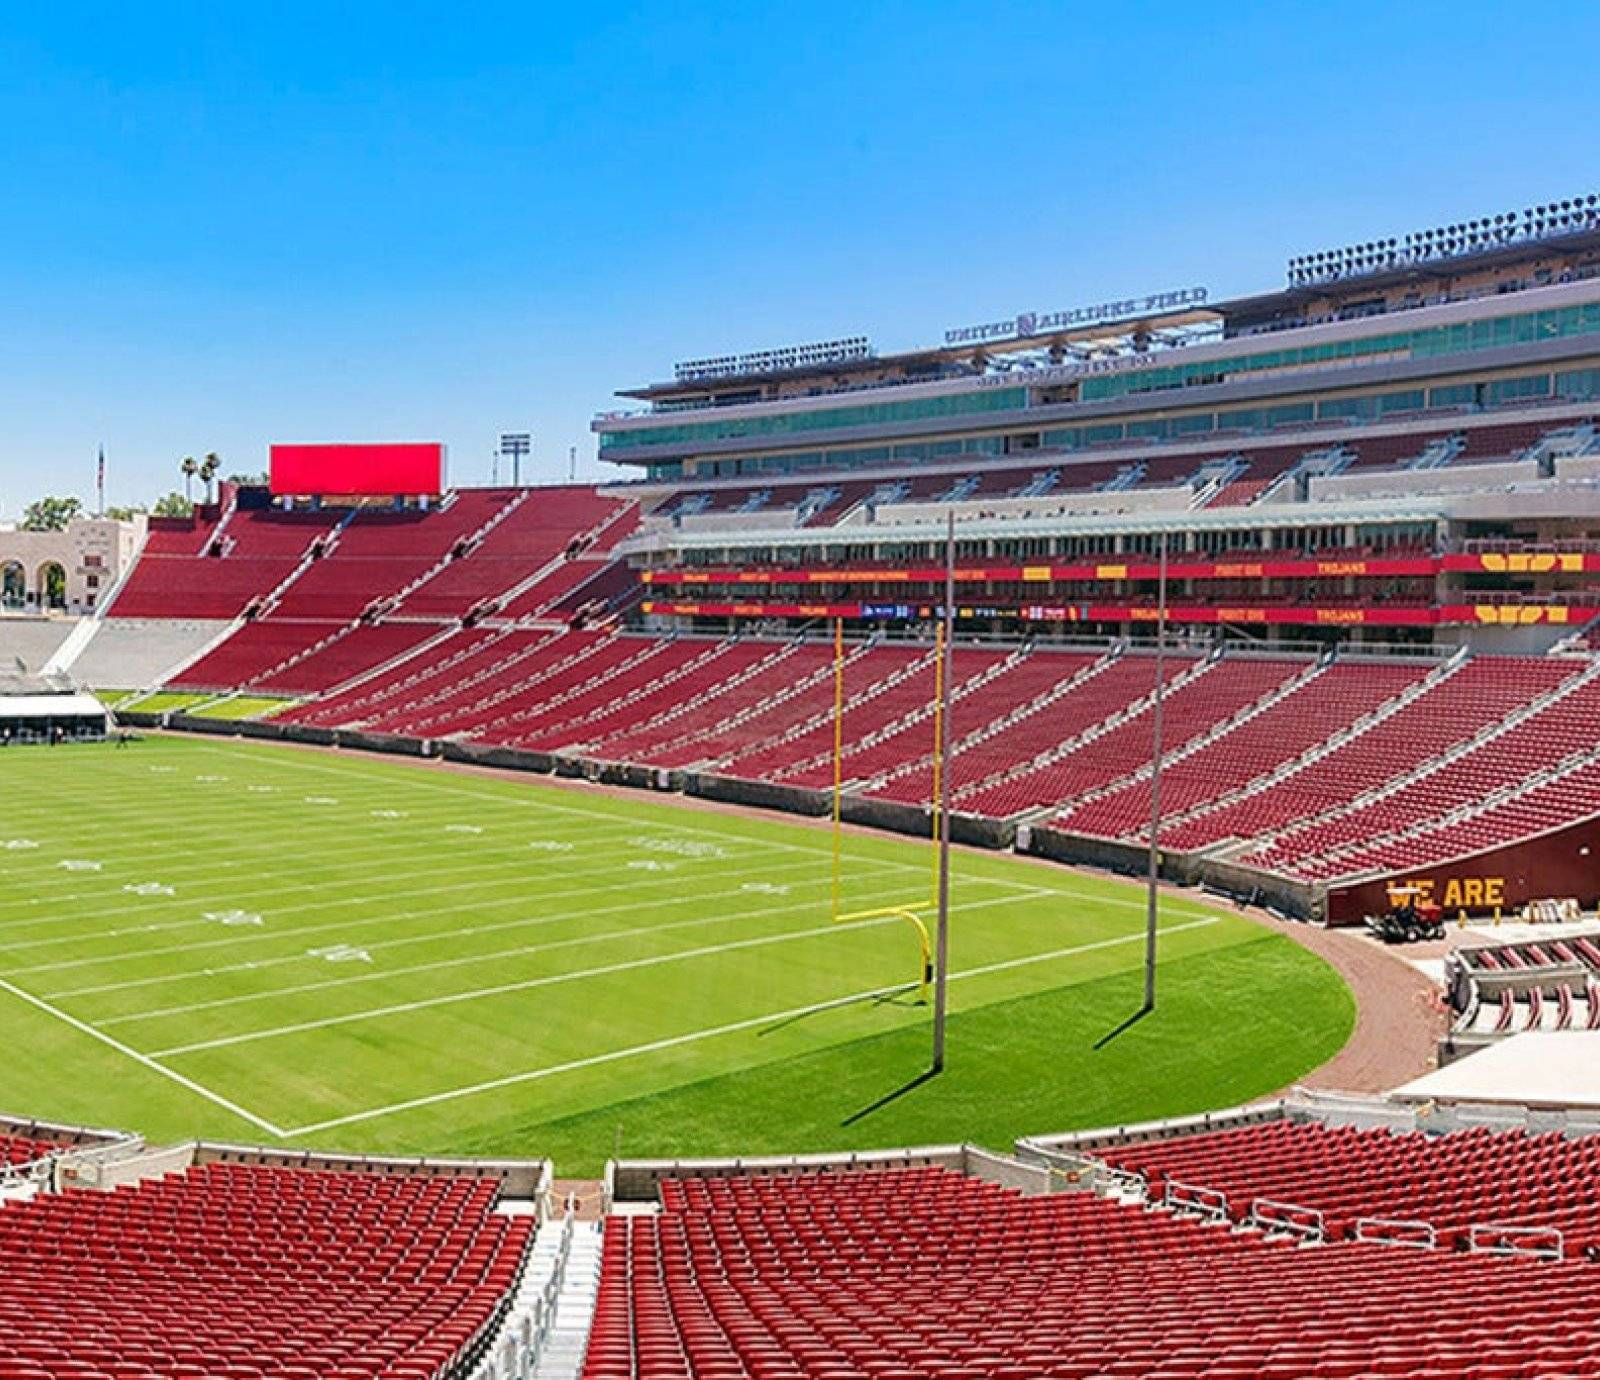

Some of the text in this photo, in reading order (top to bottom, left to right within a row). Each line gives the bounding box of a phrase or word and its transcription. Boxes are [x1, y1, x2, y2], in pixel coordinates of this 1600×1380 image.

[1036, 300, 1136, 328] AIRLINES
[1145, 287, 1208, 310] FIELD
[1386, 878, 1504, 907] WE ARE
